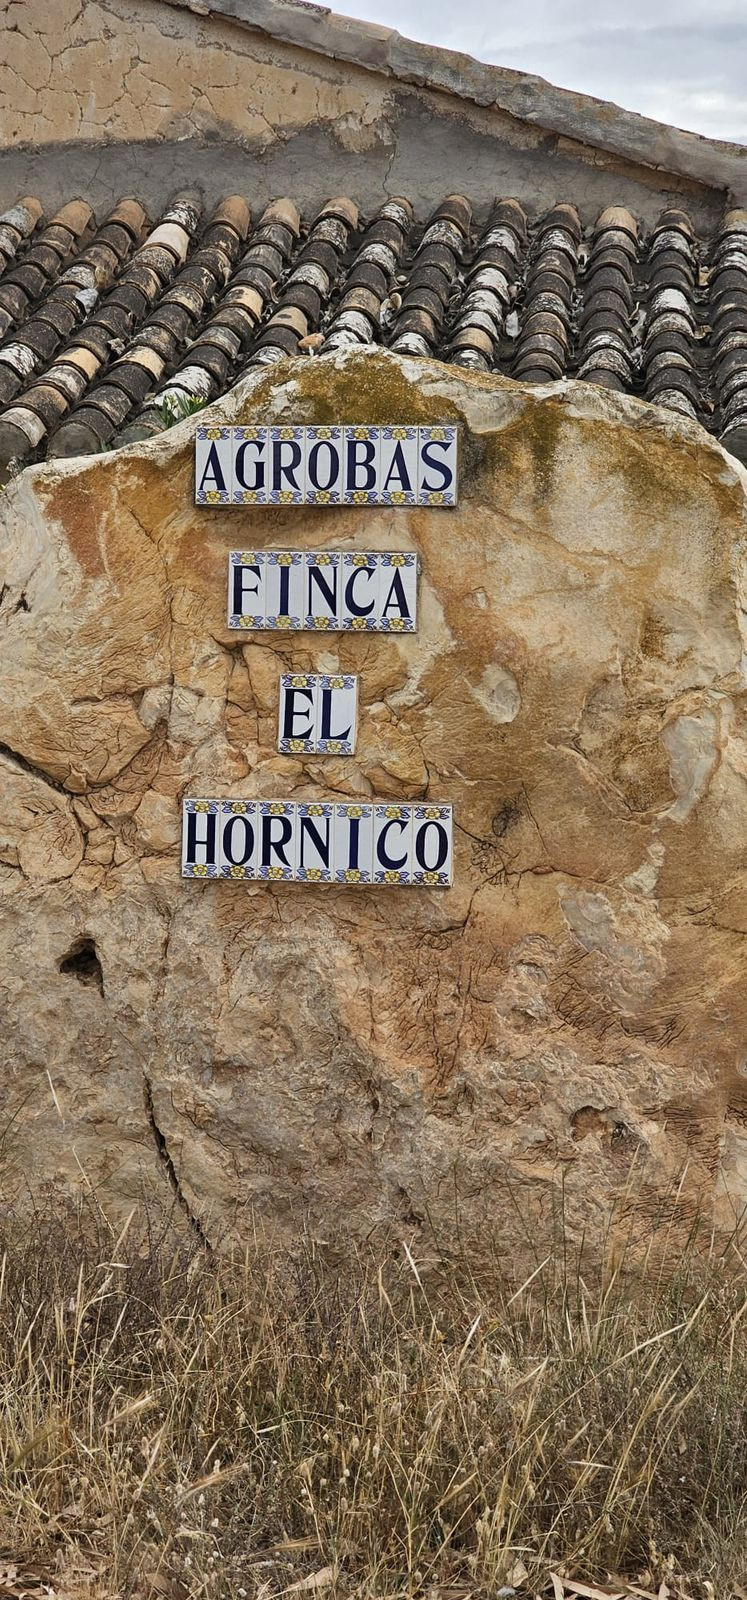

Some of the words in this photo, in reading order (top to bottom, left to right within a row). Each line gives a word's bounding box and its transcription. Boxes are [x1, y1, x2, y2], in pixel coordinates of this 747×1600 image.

[199, 440, 453, 492] AGROBAS
[232, 565, 411, 617] FINCA
[282, 688, 352, 740] EL
[186, 812, 448, 872] HORNICO
